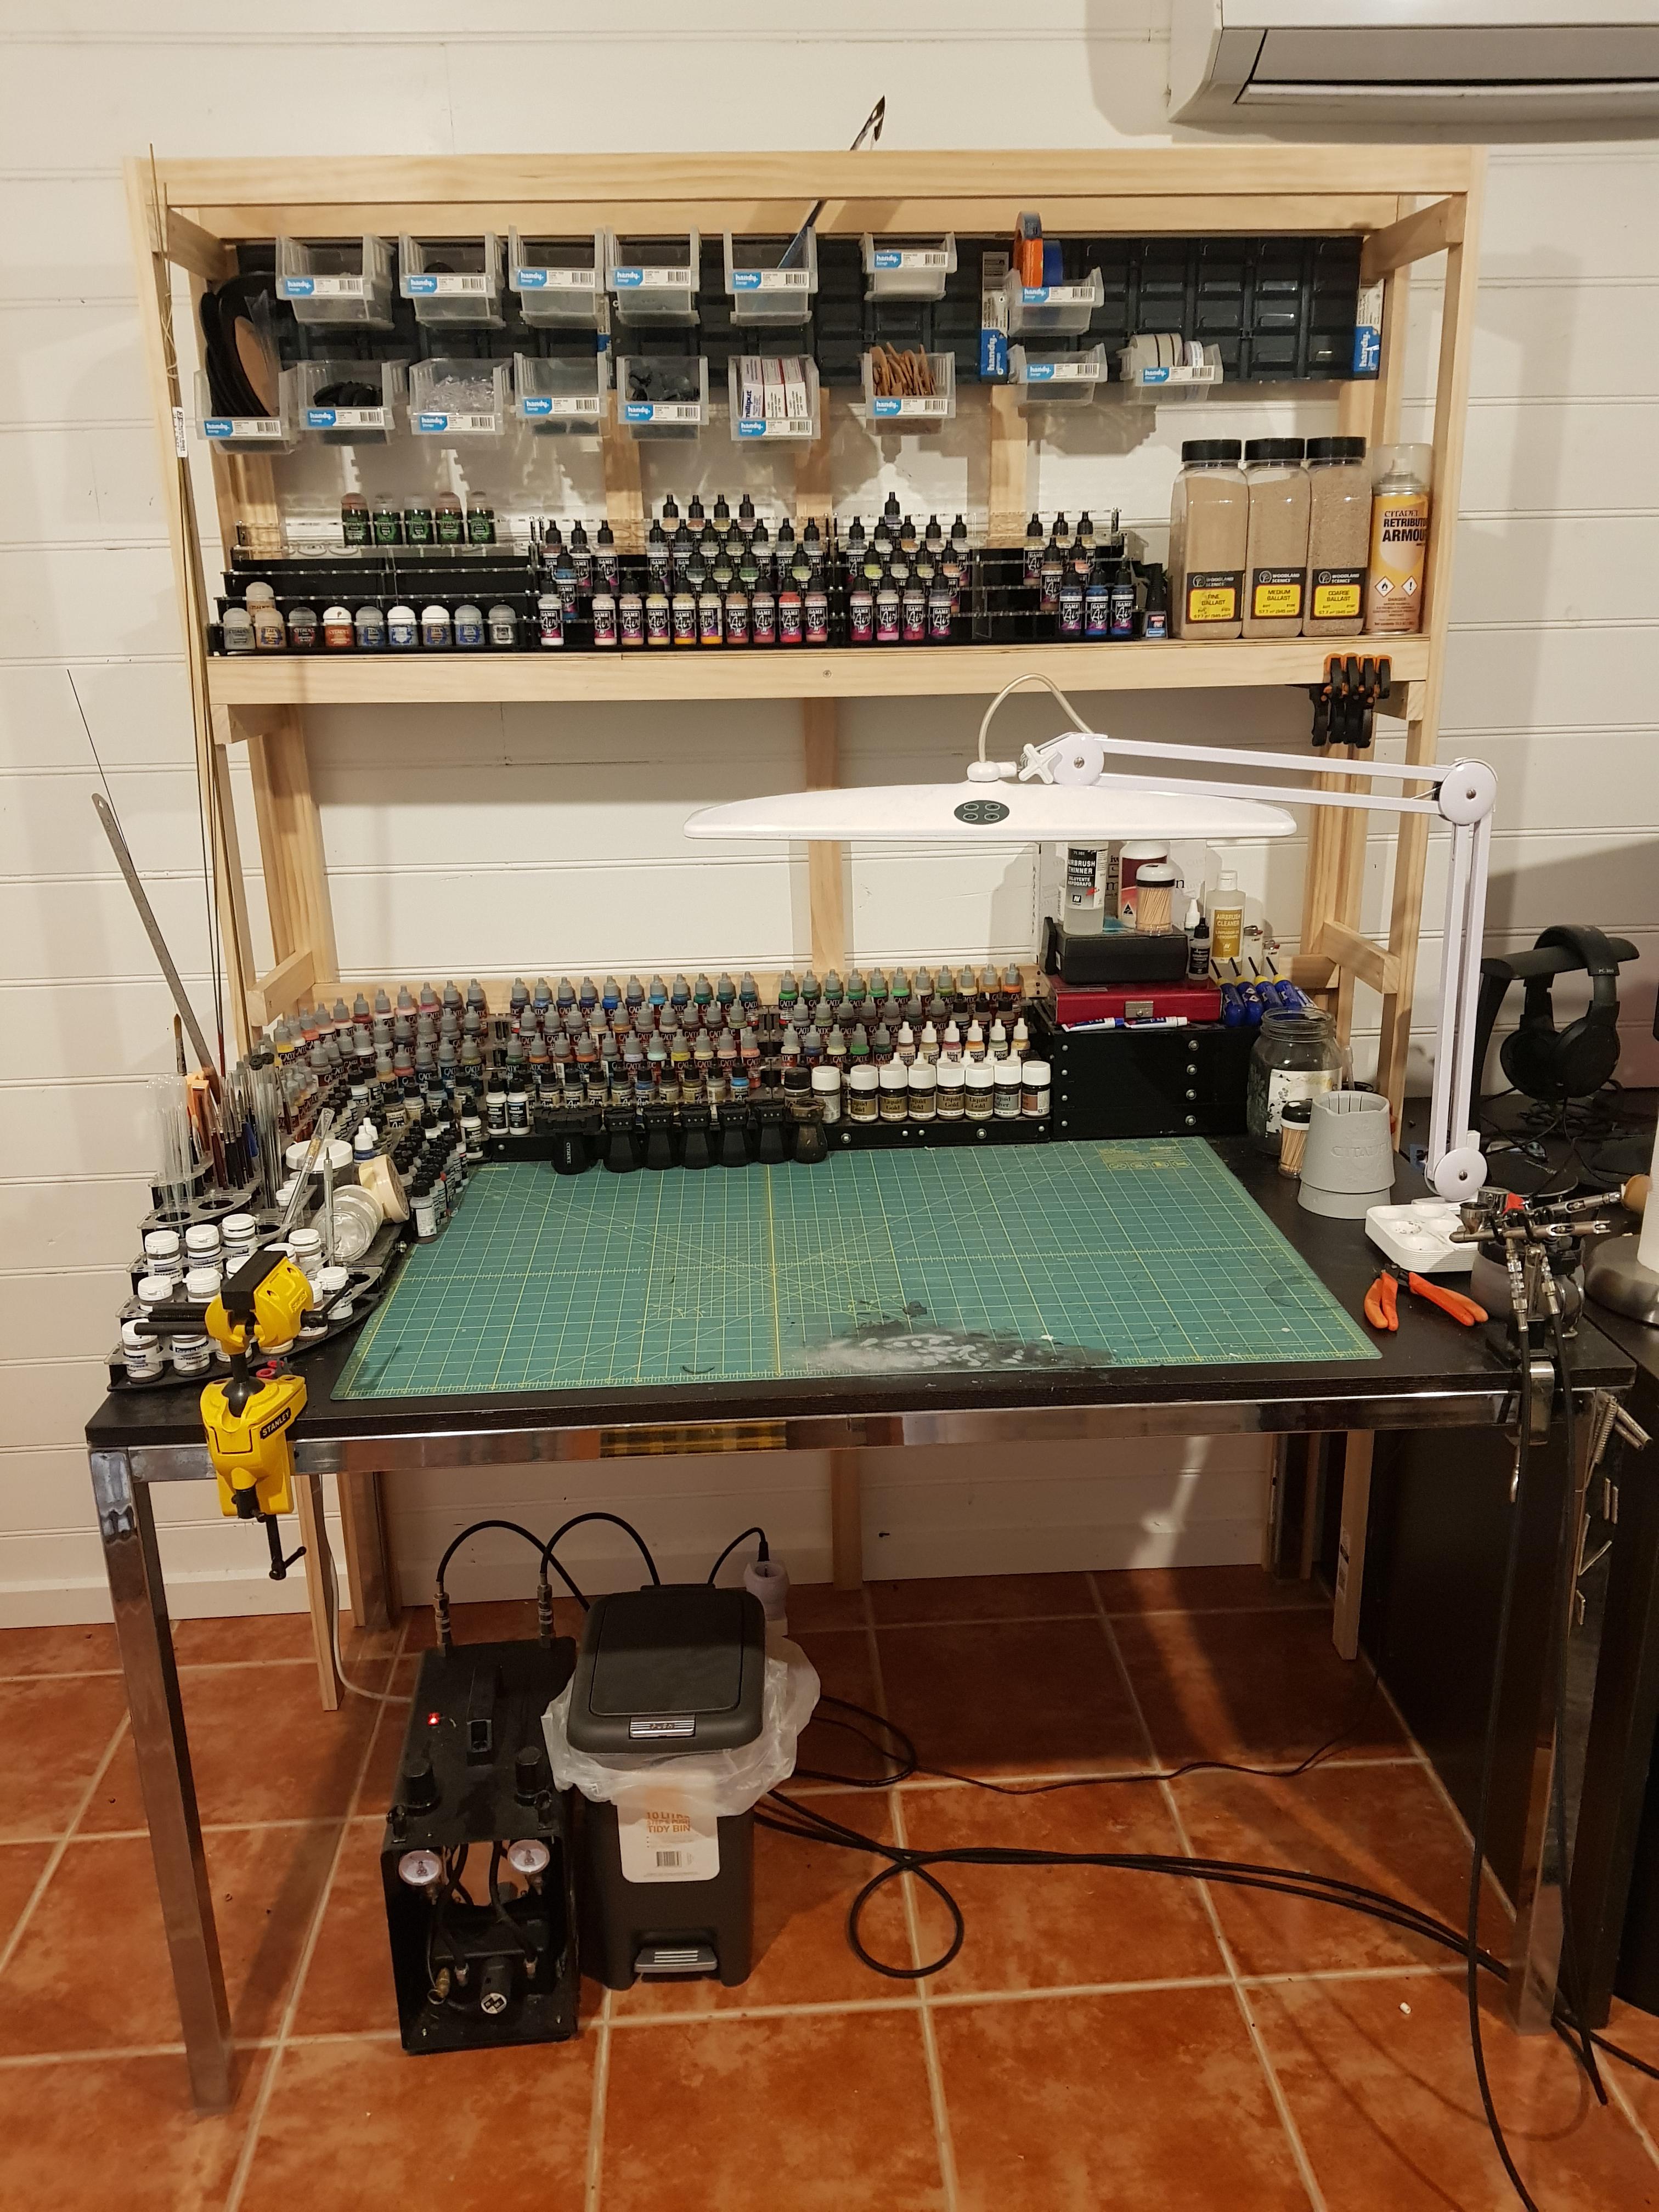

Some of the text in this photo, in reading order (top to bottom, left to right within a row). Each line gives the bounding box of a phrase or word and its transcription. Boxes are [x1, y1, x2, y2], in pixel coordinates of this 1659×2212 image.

[1383, 518, 1426, 527] RETRIBUT
[882, 611, 896, 624] Air
[908, 611, 923, 624] Air
[262, 1410, 289, 1436] STANLEY
